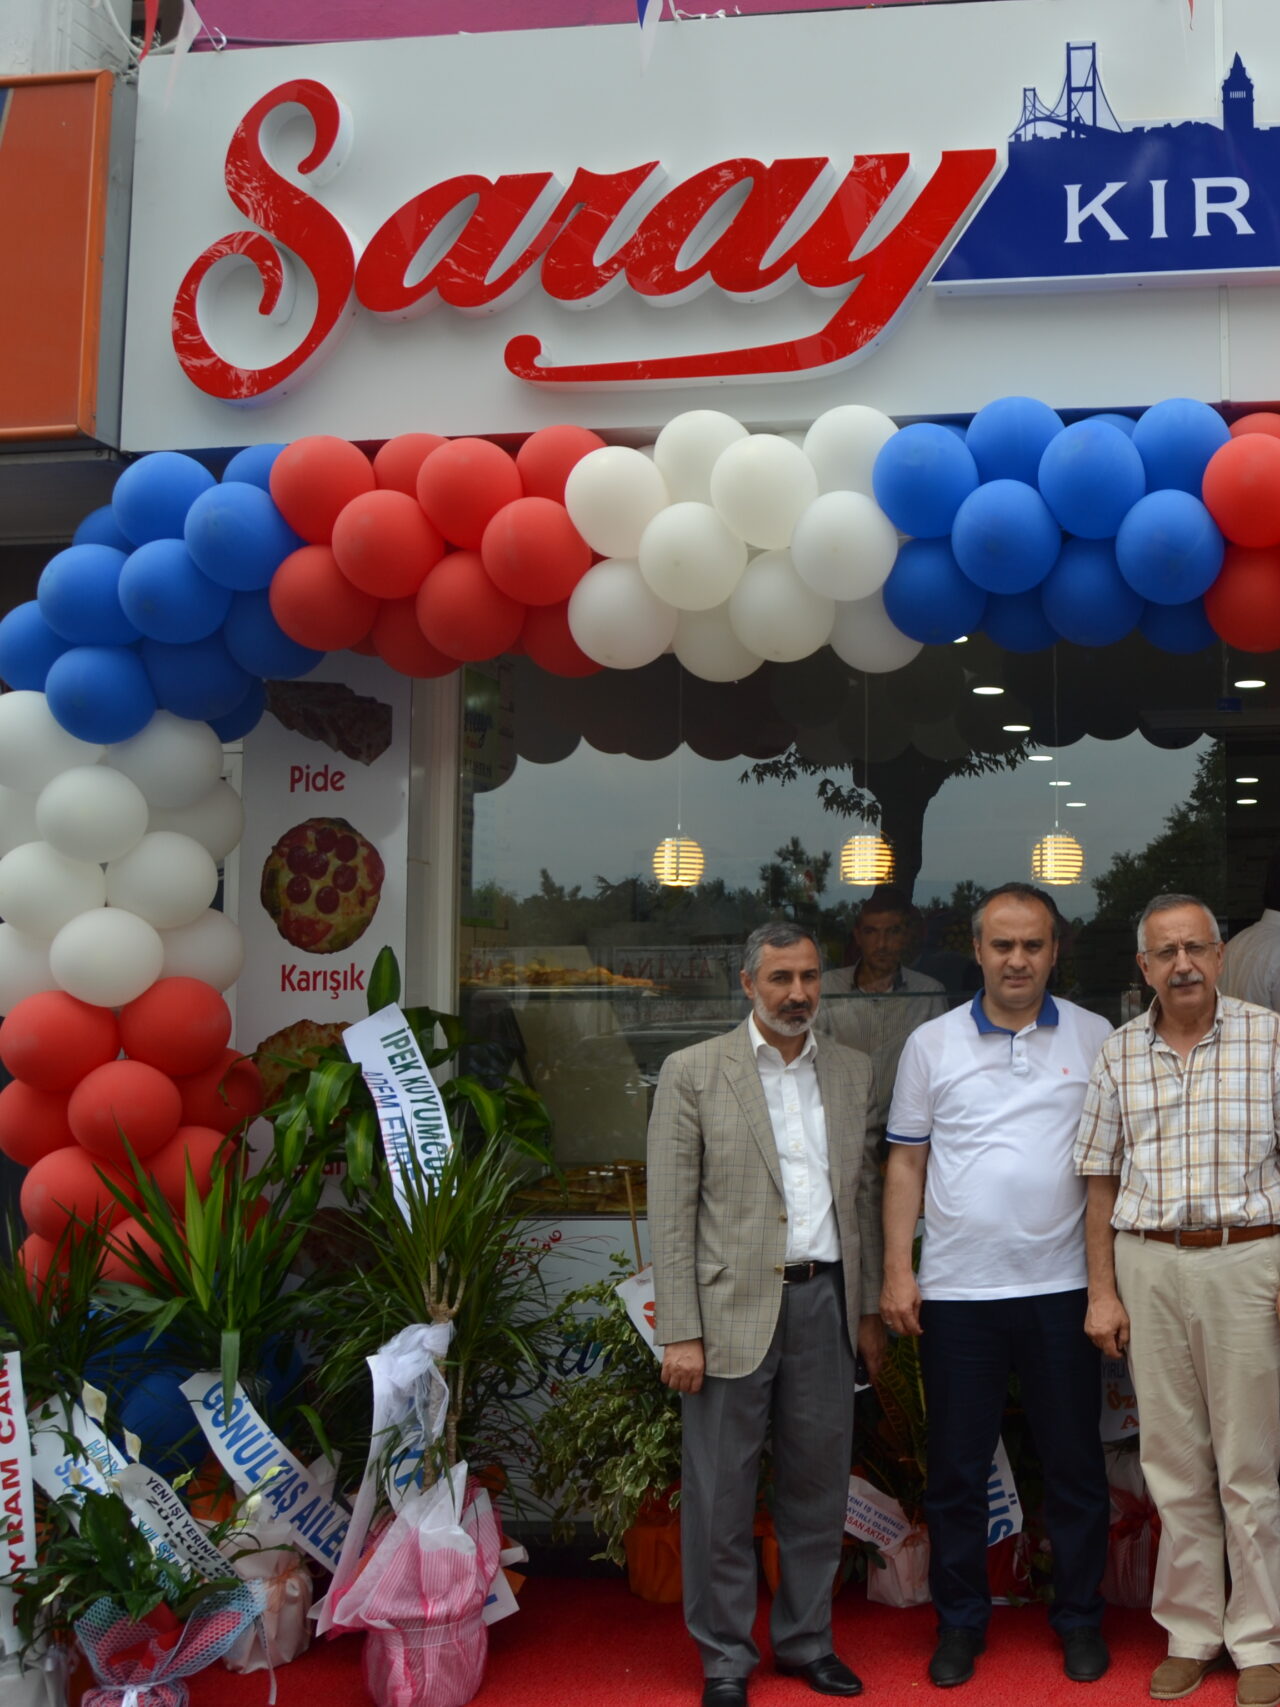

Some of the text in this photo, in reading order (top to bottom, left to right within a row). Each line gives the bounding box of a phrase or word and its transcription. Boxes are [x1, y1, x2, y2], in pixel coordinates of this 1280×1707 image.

[1062, 175, 1257, 244] KIR
[171, 78, 1000, 402] Saray
[289, 764, 346, 793] Pide
[280, 962, 366, 1000] Karışık
[379, 1026, 423, 1076] İPEK
[145, 1476, 174, 1504] YENİ
[181, 1520, 222, 1561] YERİNİZ
[847, 1516, 865, 1530] SAN
